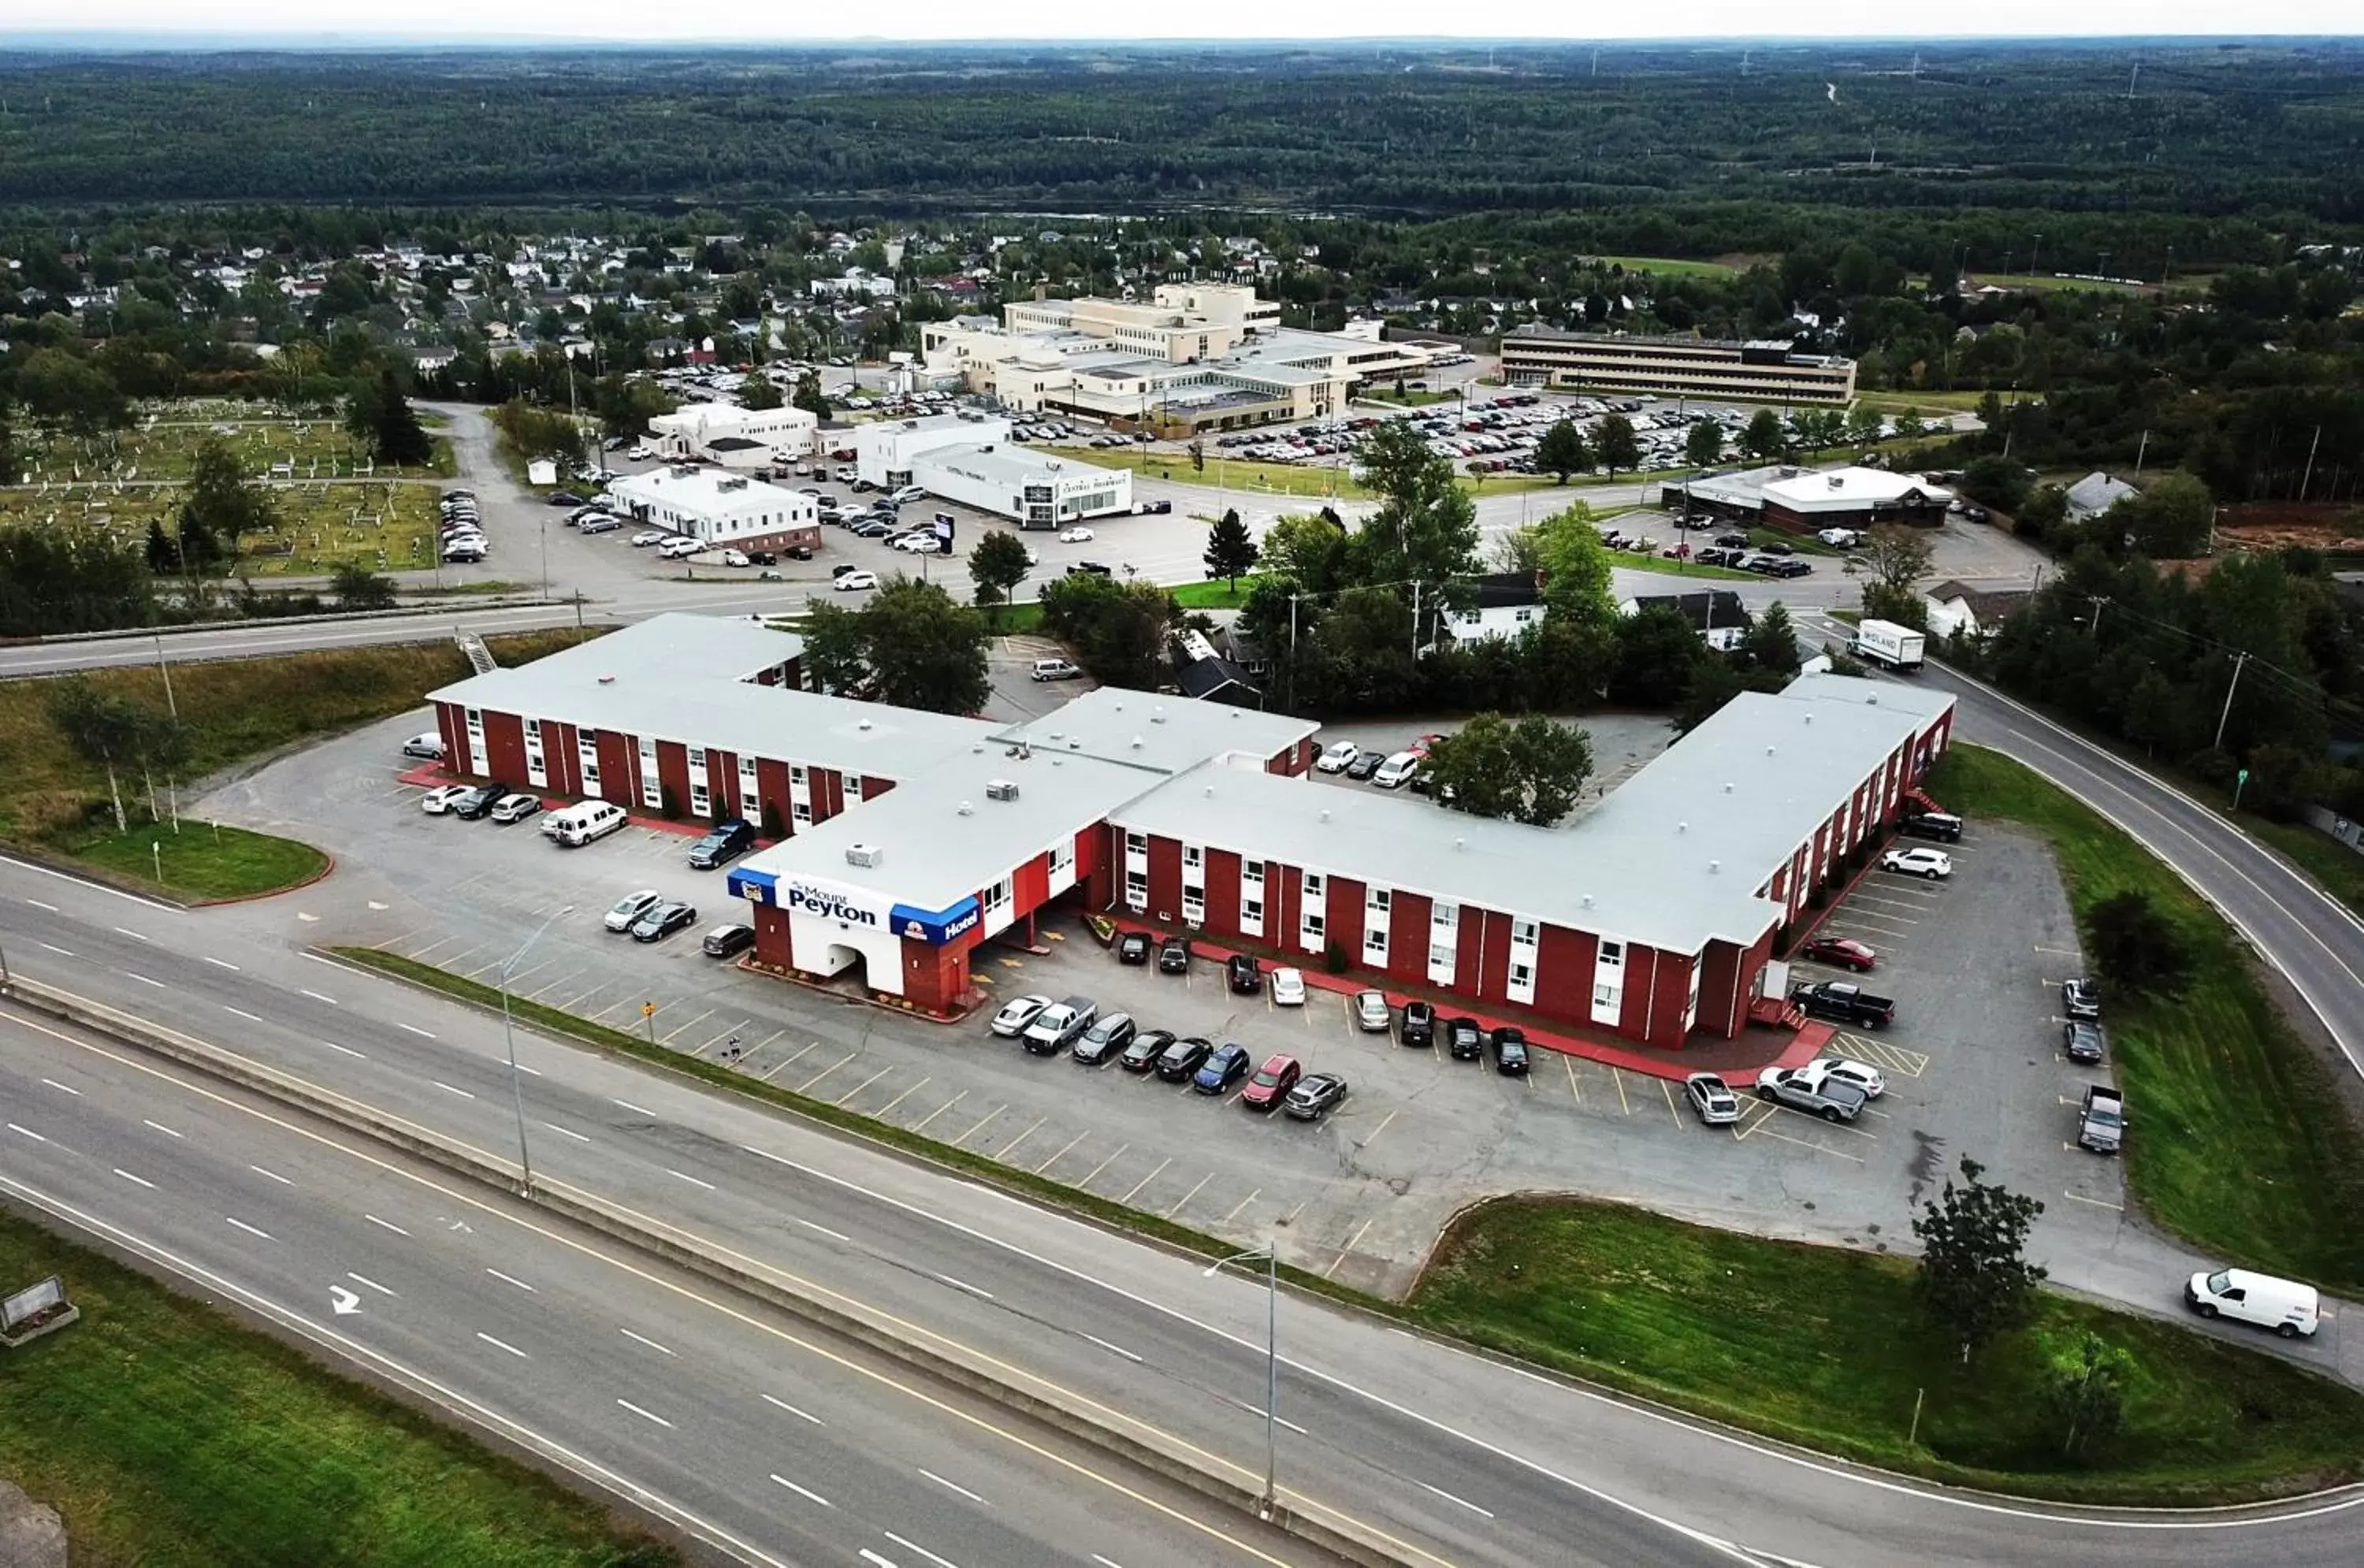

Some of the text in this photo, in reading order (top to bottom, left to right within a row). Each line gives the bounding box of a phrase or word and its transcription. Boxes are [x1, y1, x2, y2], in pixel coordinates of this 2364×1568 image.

[1864, 630, 1897, 649] MIDLAND
[789, 889, 876, 926] Peyton
[805, 886, 848, 905] Mount
[945, 909, 978, 940] Hotel
